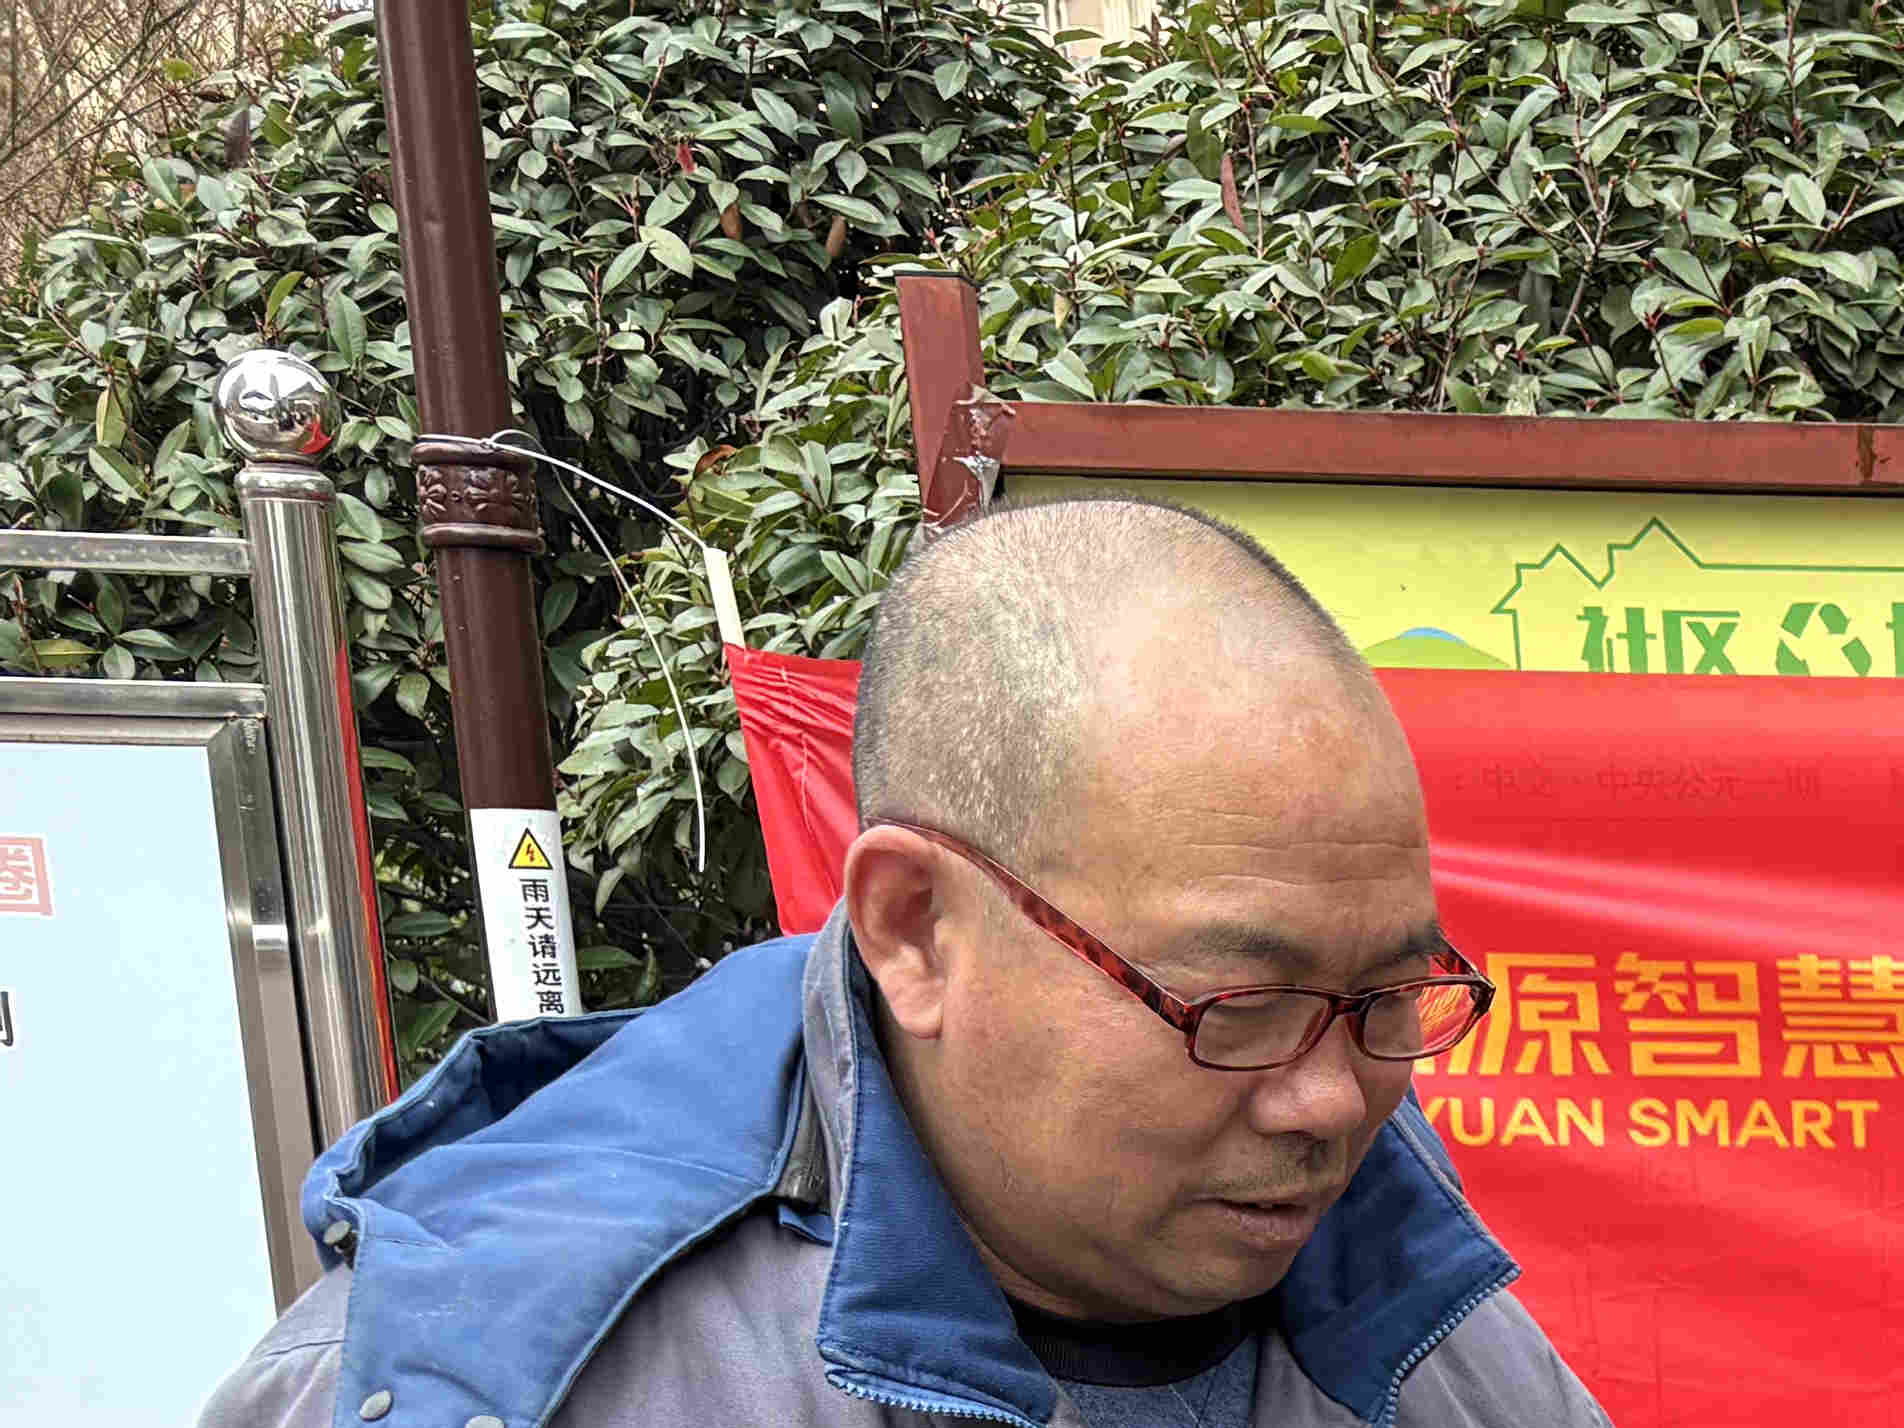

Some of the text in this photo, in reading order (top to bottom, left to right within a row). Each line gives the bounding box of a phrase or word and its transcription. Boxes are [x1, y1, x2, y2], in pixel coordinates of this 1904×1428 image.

[519, 878, 565, 1015] 雨天请远离
[1629, 1099, 1879, 1150] SMART
